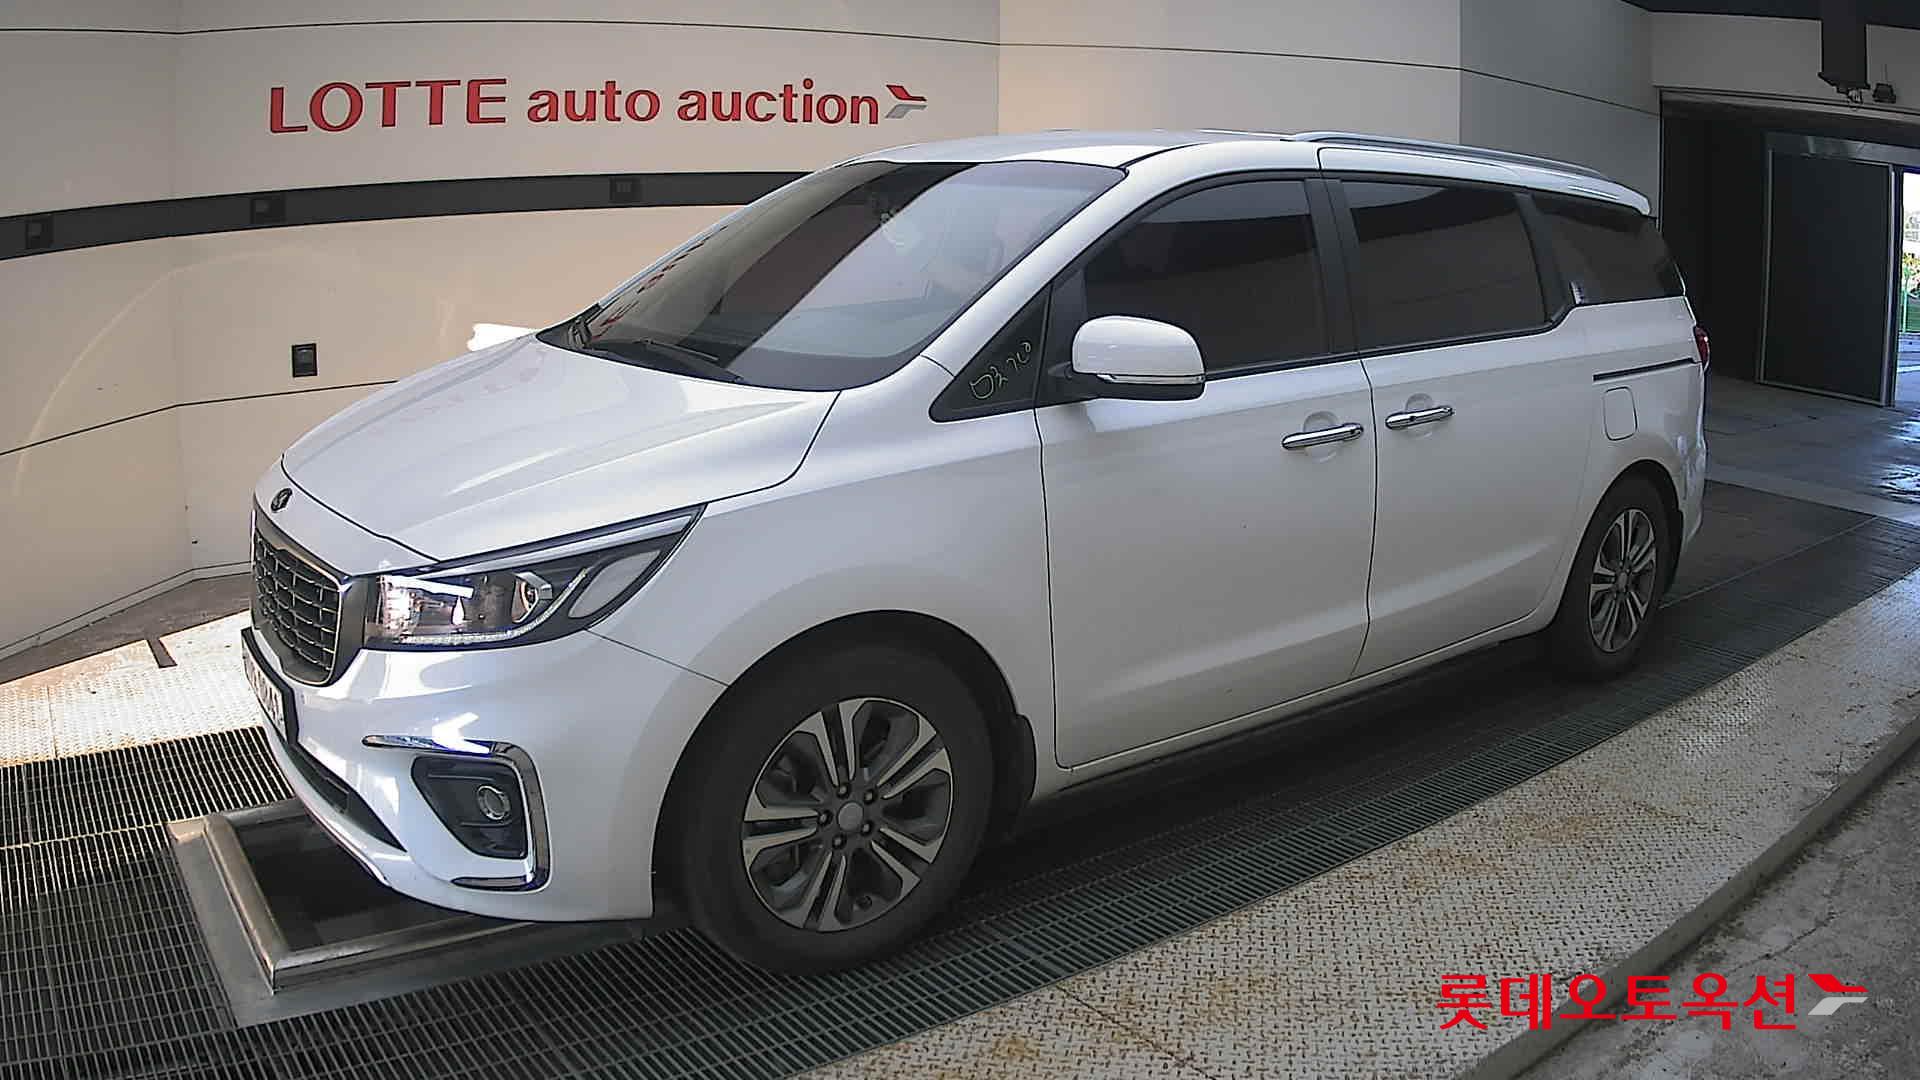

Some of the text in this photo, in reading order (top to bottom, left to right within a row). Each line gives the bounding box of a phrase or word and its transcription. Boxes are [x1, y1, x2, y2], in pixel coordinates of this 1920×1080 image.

[269, 78, 880, 134] LOTTE auto auction
